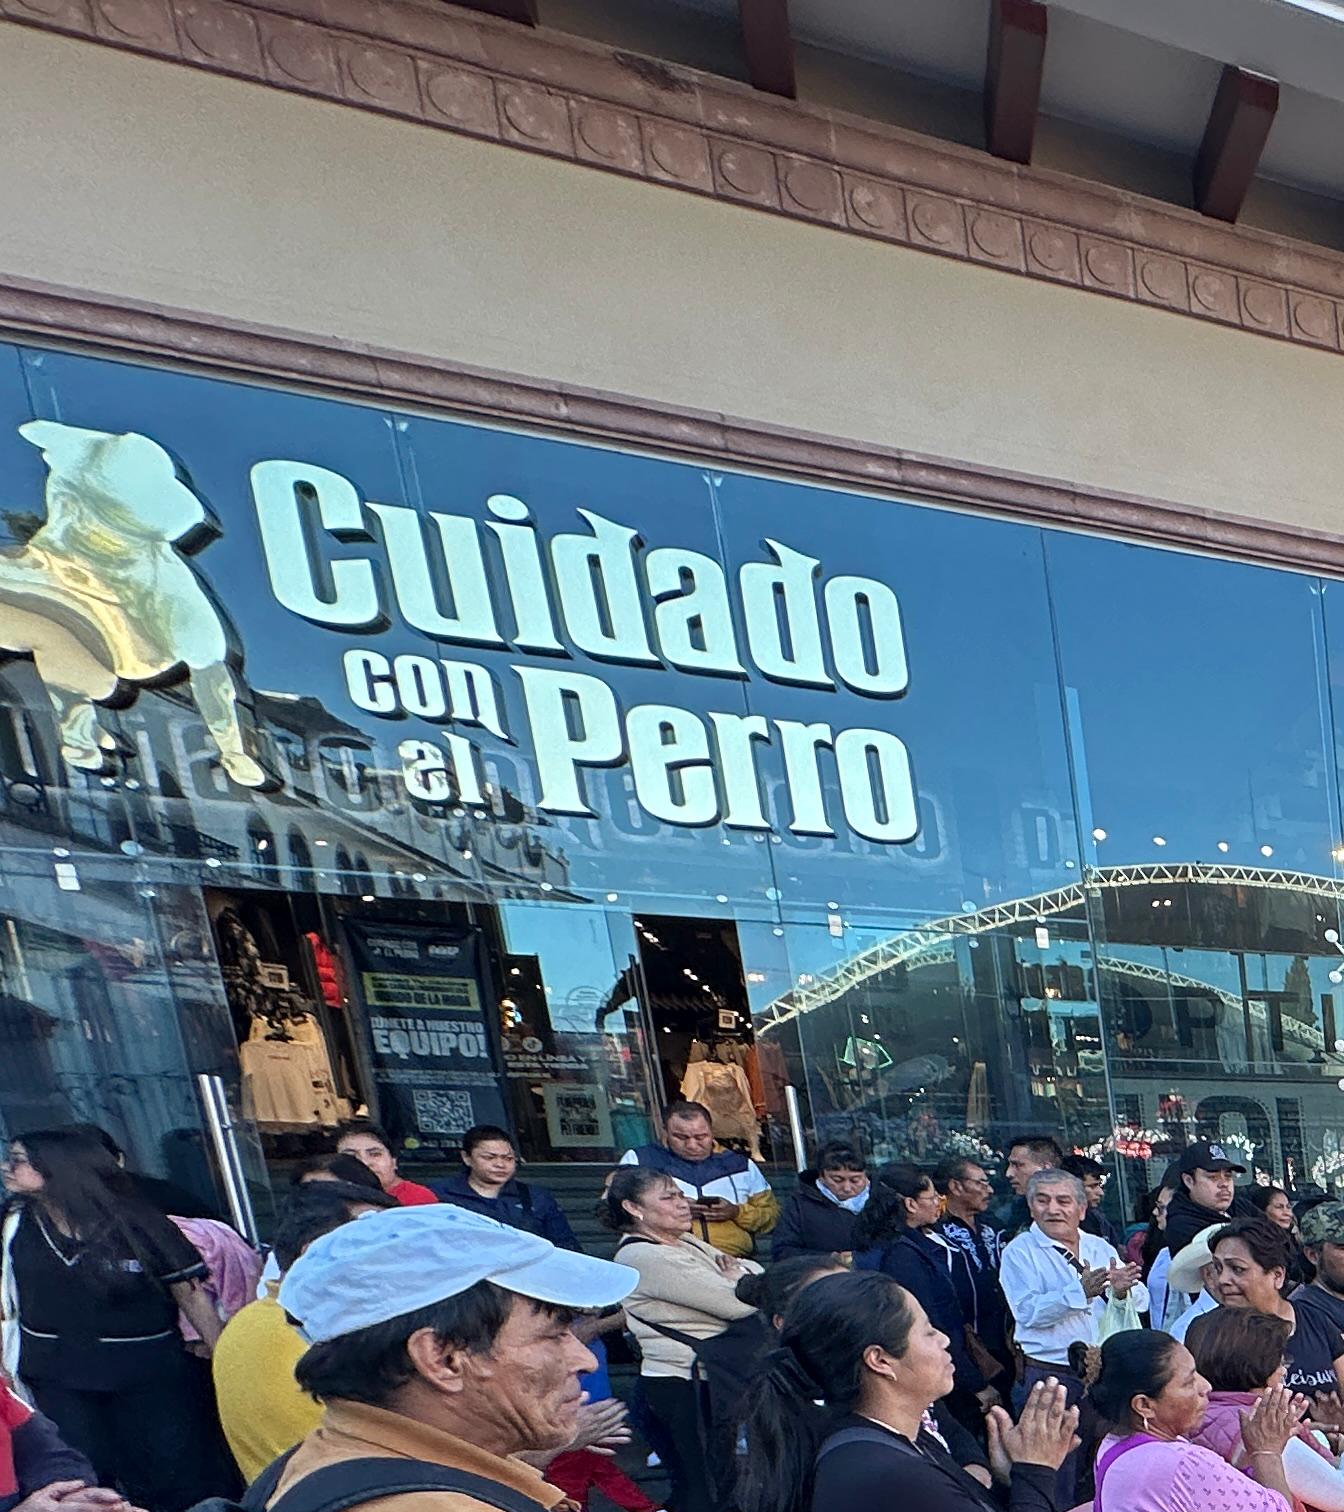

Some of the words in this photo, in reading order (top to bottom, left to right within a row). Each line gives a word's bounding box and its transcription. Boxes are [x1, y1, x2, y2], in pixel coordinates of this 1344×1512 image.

[250, 459, 912, 699] Cuidado
[343, 648, 515, 745] con
[397, 731, 487, 810] el
[510, 664, 920, 845] Perro
[373, 1029, 489, 1060] EQUIPO!
